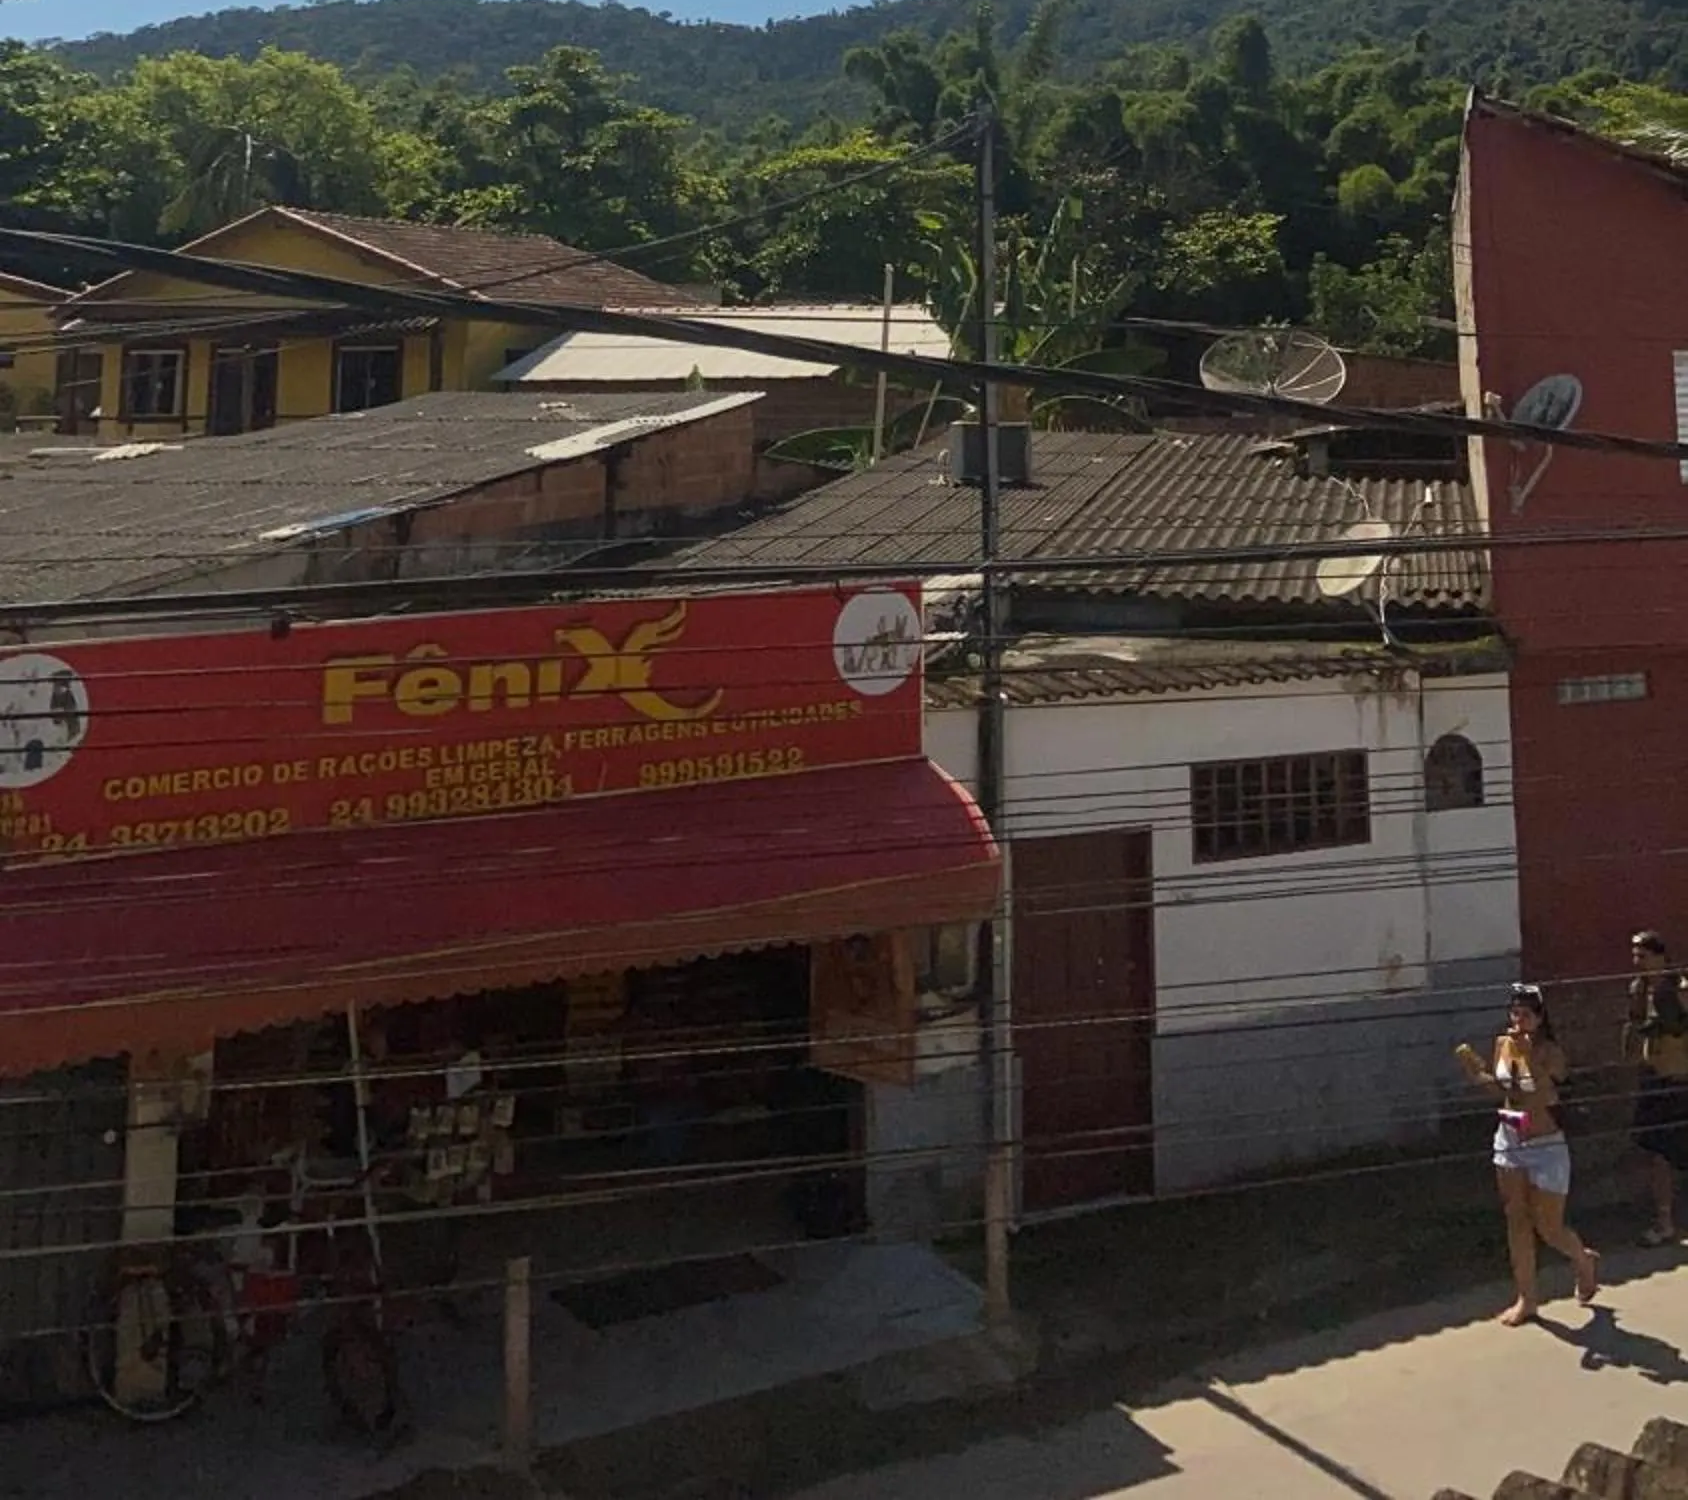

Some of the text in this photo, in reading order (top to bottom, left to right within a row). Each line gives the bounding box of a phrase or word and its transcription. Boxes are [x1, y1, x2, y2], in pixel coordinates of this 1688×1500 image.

[104, 764, 262, 801] COMERCIO
[273, 760, 308, 783] DE
[318, 744, 432, 779] RAÇÕES
[563, 719, 708, 753] FERRAGENS
[426, 757, 556, 789] EM GERAL
[329, 797, 374, 828] 24
